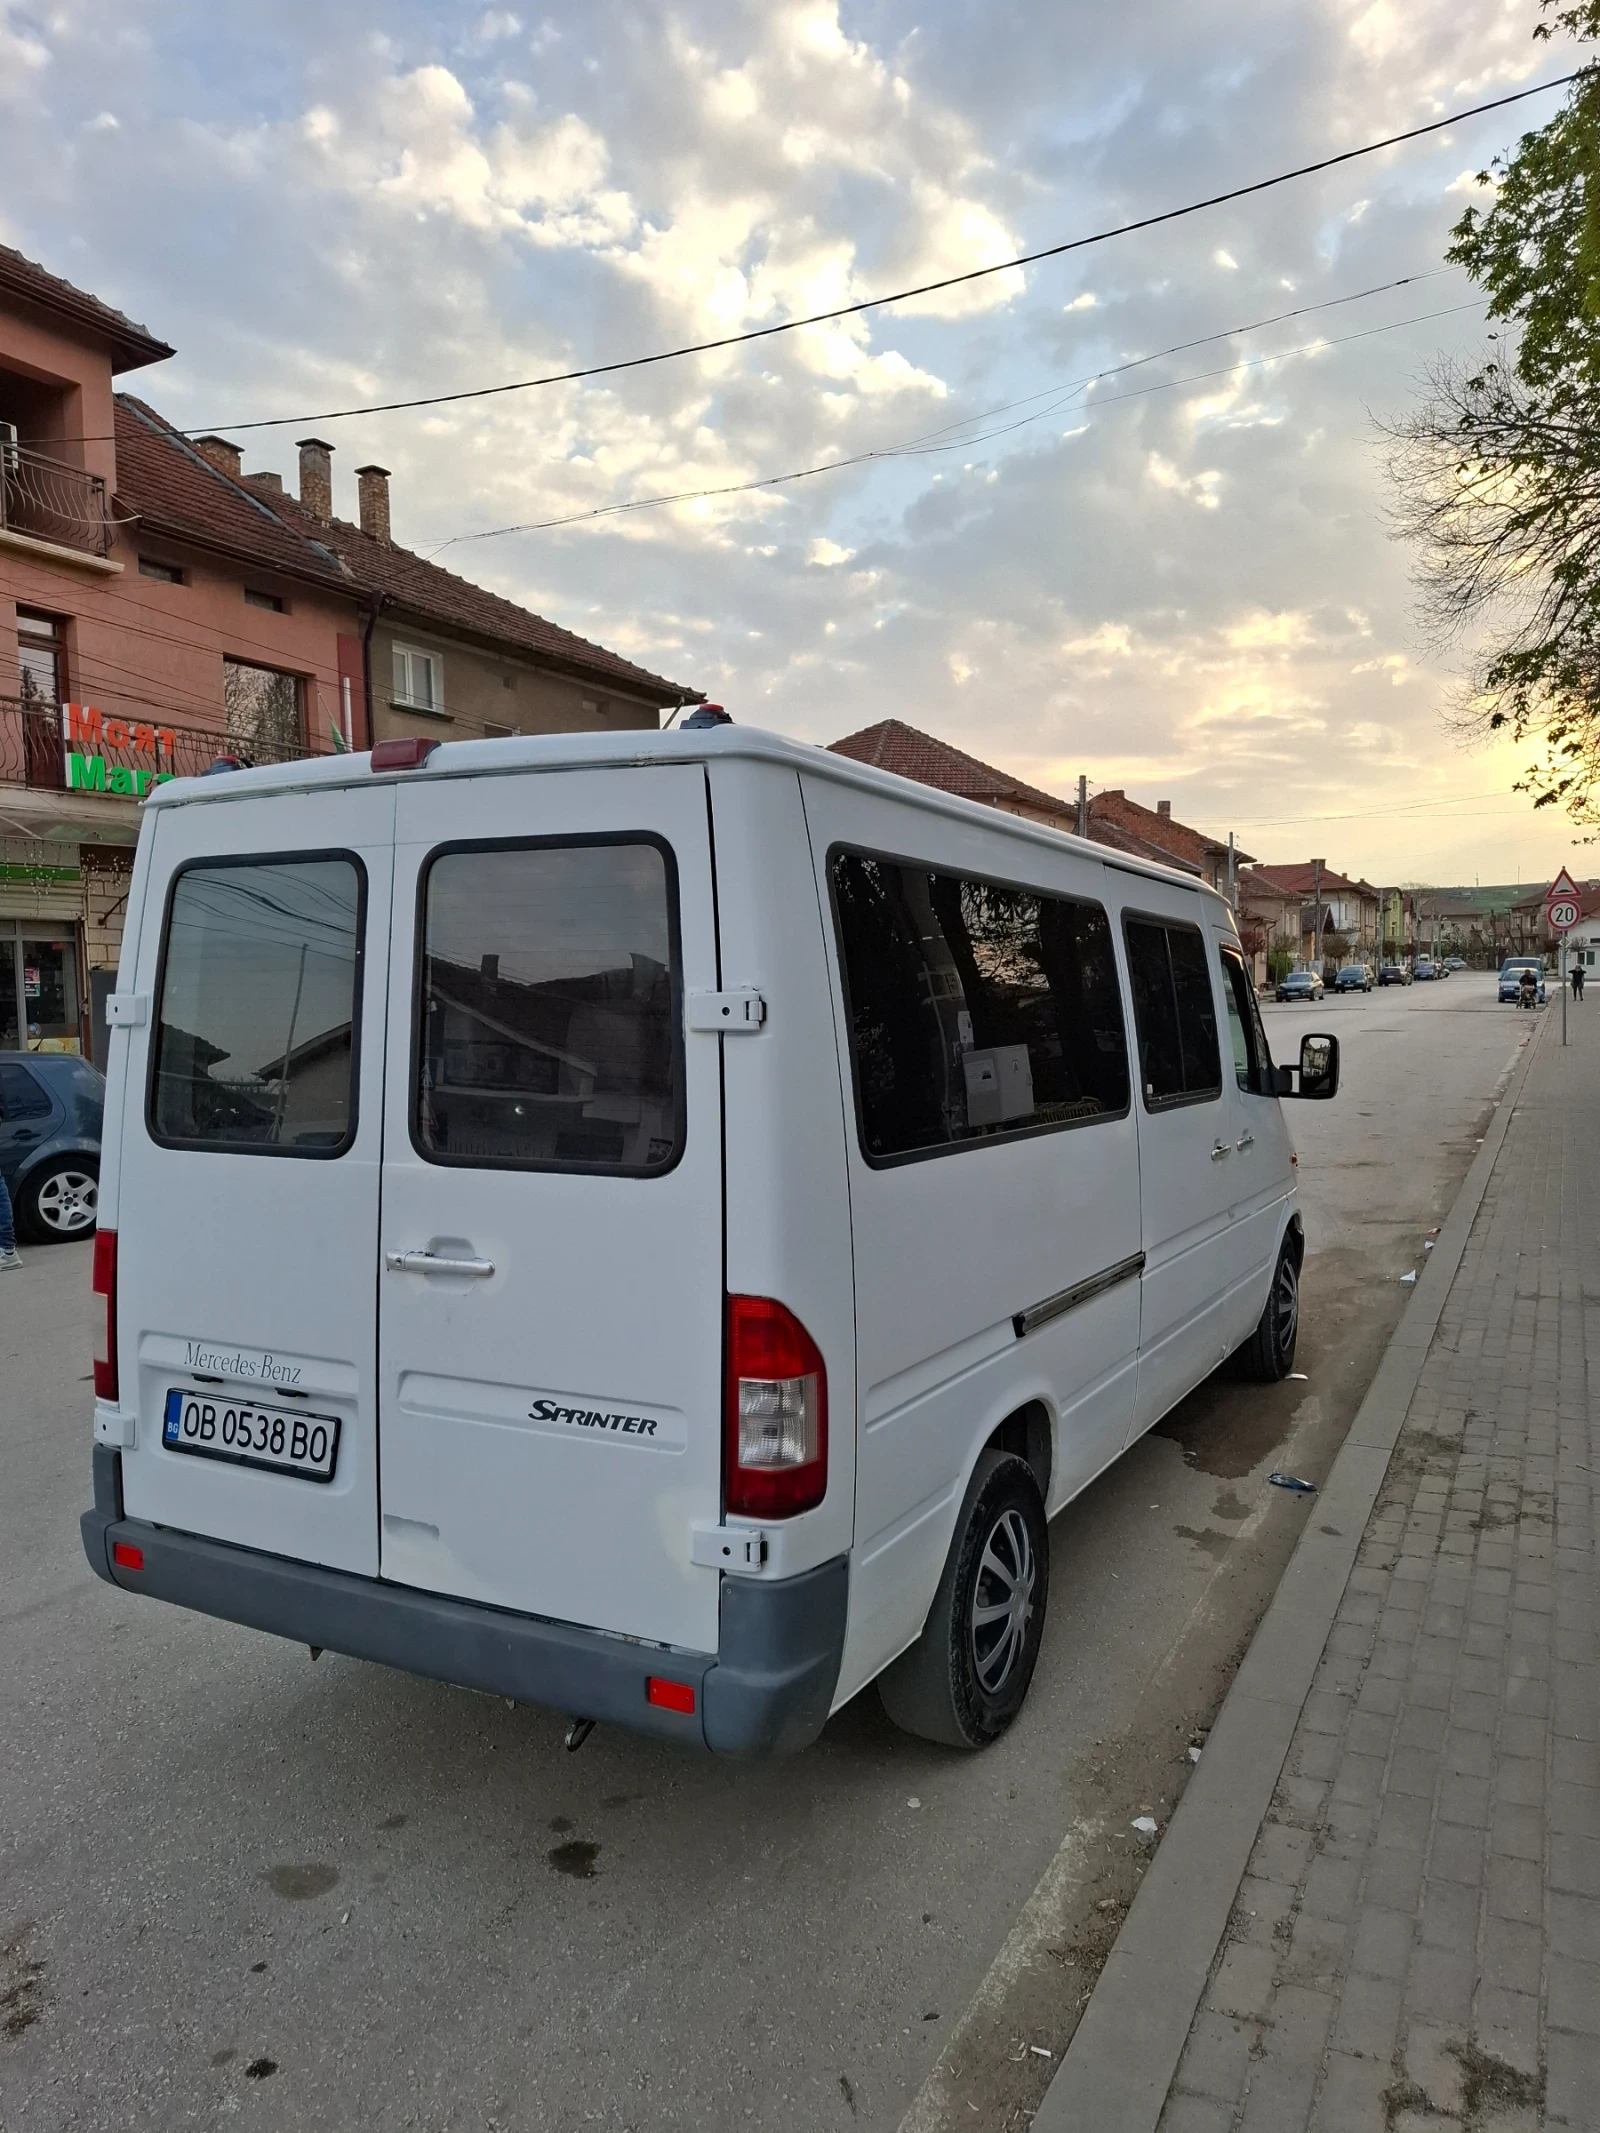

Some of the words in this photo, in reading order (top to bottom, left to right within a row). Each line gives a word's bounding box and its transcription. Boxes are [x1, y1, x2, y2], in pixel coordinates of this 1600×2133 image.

[63, 703, 177, 755] Моят
[1555, 907, 1574, 922] 20
[184, 1342, 302, 1384] Mercedes-Benz
[167, 1421, 179, 1434] BG
[183, 1402, 217, 1441] OB
[222, 1409, 286, 1455] 0538
[289, 1420, 328, 1463] BO
